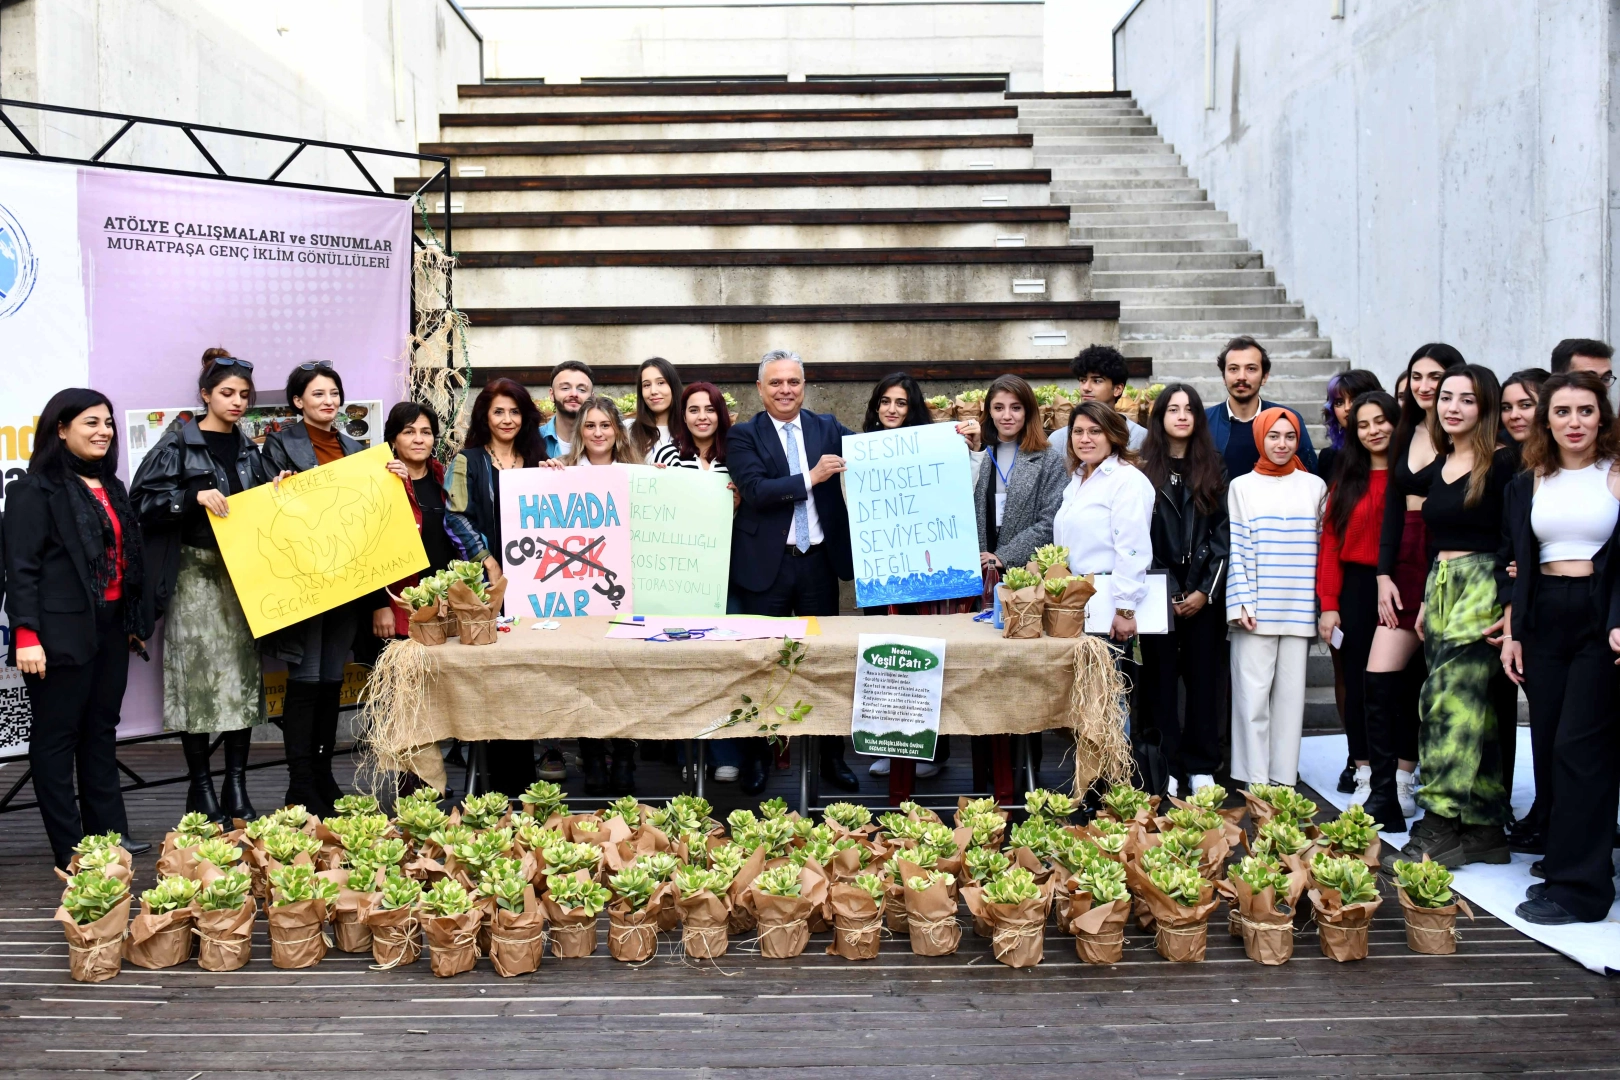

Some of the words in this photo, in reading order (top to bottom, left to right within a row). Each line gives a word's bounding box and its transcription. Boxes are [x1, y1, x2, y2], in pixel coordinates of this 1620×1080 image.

[104, 216, 170, 234] ATÖLYE
[174, 222, 285, 243] ÇALIŞMALARI
[290, 234, 306, 244] ve
[310, 234, 392, 252] SUNUMLAR
[107, 237, 205, 257] MURATPAŞA
[210, 245, 249, 261] GENÇ
[253, 246, 294, 262] İKLİM
[298, 250, 390, 268] GÖNÜLLÜLERİ
[854, 431, 920, 462] SESİNİ
[268, 469, 337, 508] HAREKETE
[854, 462, 945, 493] YÜKSELT
[518, 491, 621, 529] HAVADA
[856, 493, 920, 524] DENİZ
[860, 515, 958, 554] SEVİYESİNİ
[862, 552, 920, 580] DEĞİL
[528, 590, 590, 618] VAR
[870, 654, 896, 668] Yeşil
[898, 656, 921, 669] Çatı
[924, 658, 932, 670] ?
[892, 647, 912, 656] Neden
